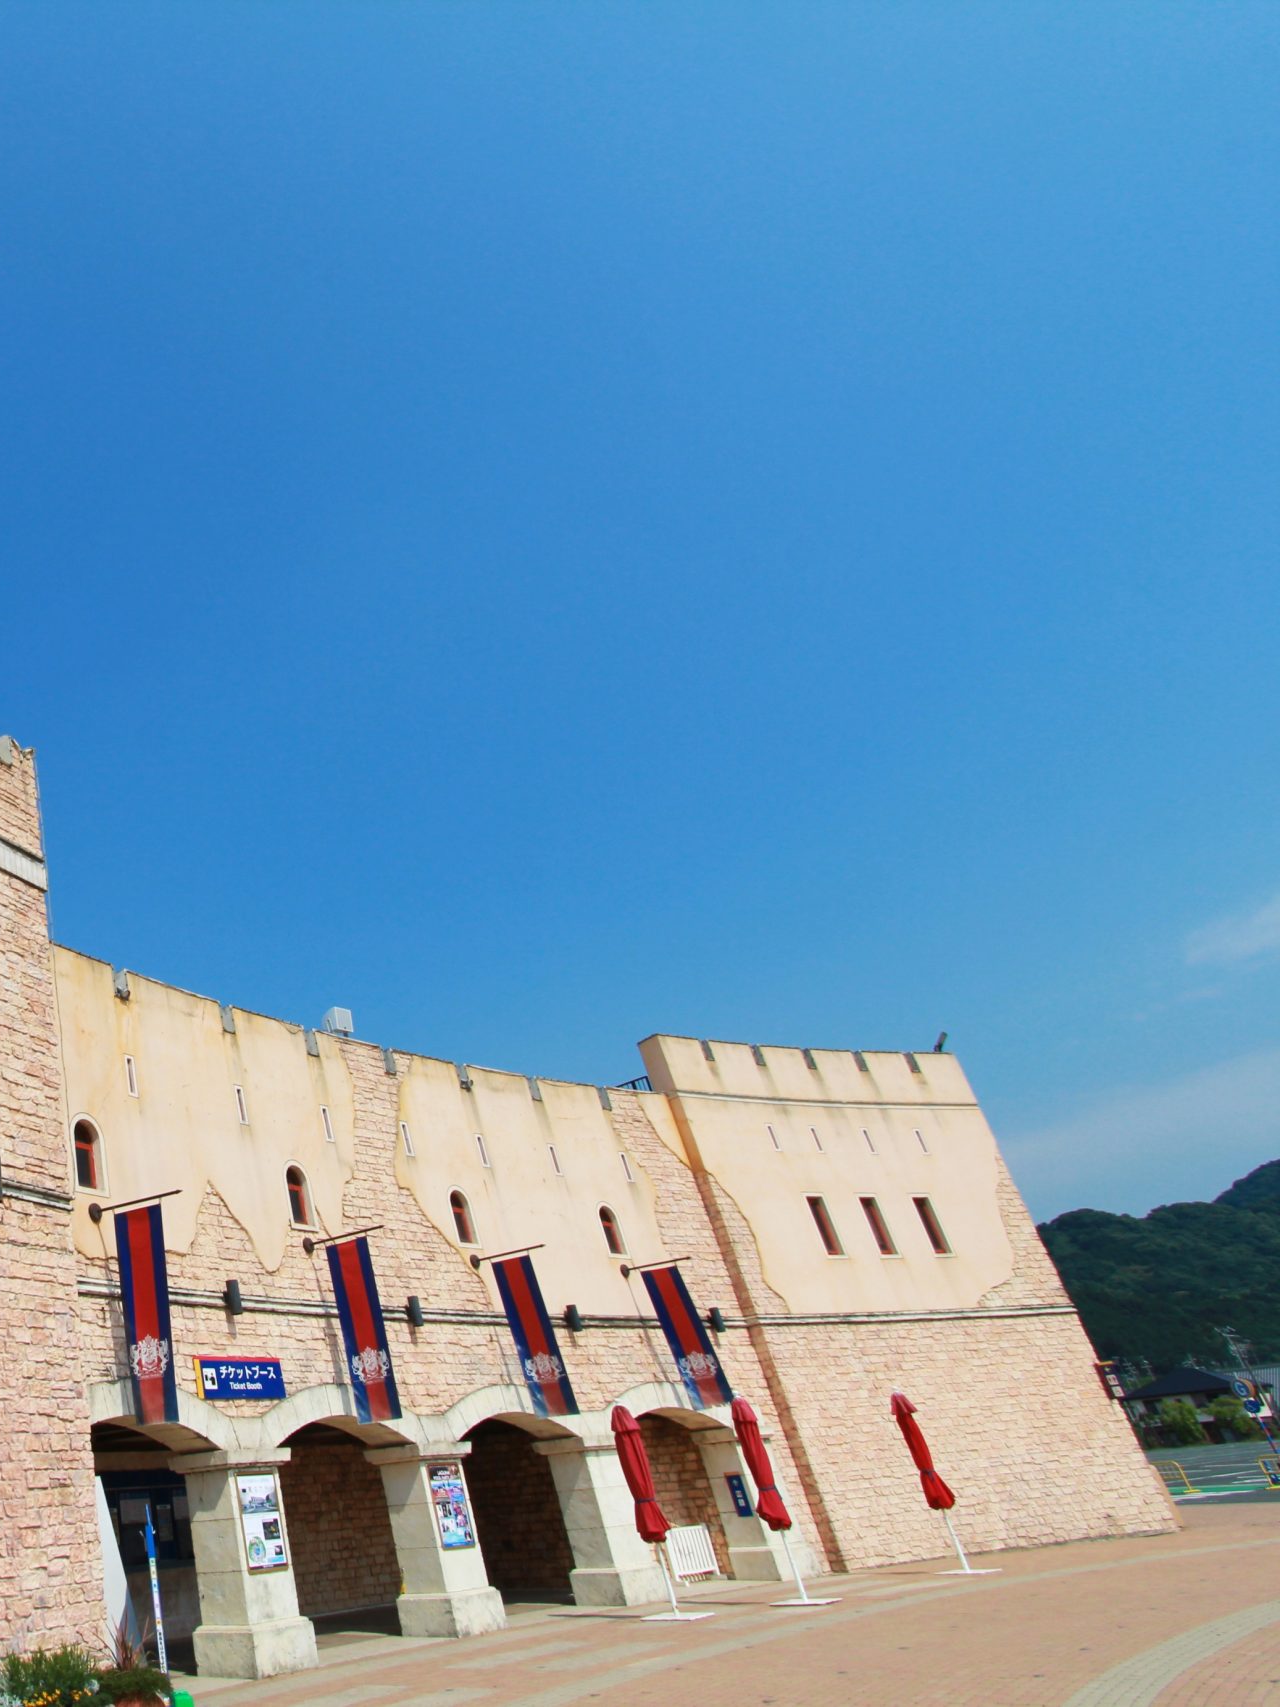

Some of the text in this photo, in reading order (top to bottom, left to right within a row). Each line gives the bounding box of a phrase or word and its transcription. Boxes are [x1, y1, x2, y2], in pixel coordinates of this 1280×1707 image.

[220, 1365, 276, 1379] チケットブース
[229, 1382, 262, 1390] Ticket Booth
